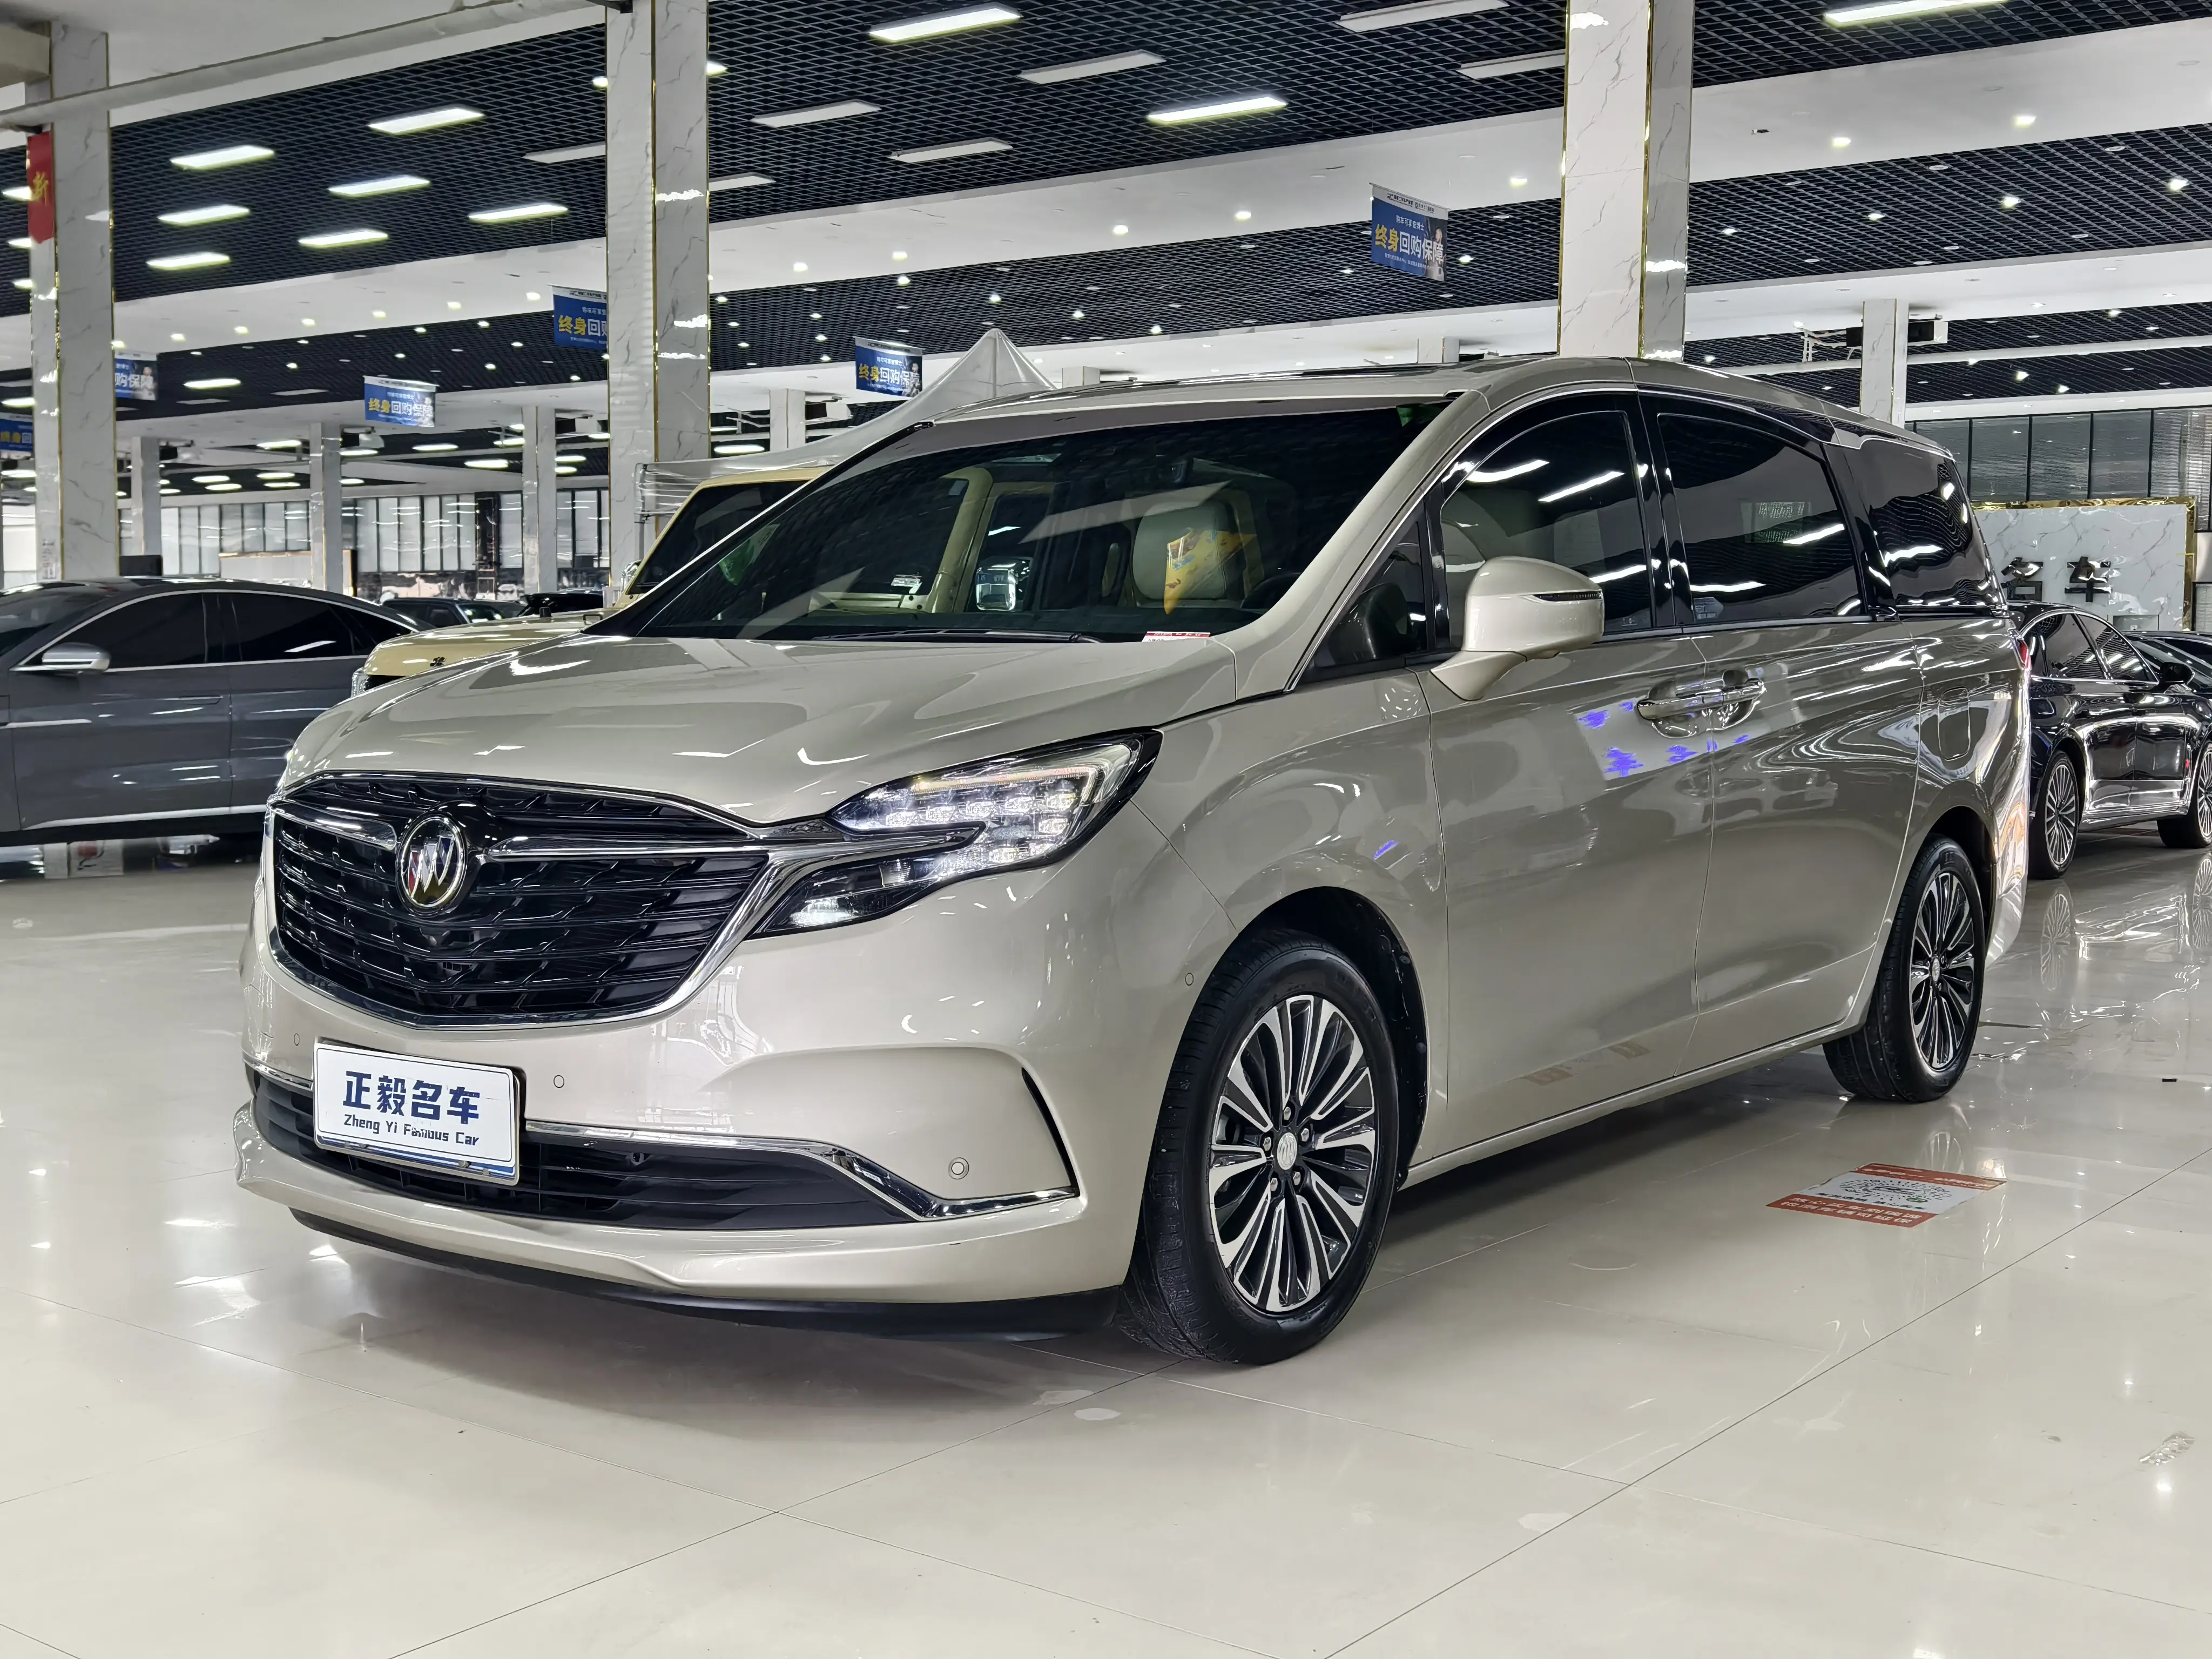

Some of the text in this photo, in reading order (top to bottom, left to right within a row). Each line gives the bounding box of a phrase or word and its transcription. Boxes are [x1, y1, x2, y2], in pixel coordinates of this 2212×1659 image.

[1375, 224, 1444, 264] 终身回购保障
[2001, 556, 2112, 603] 名车
[342, 1070, 480, 1125] 正毅名车
[343, 1114, 480, 1146] Zheng Yi Famous Car
